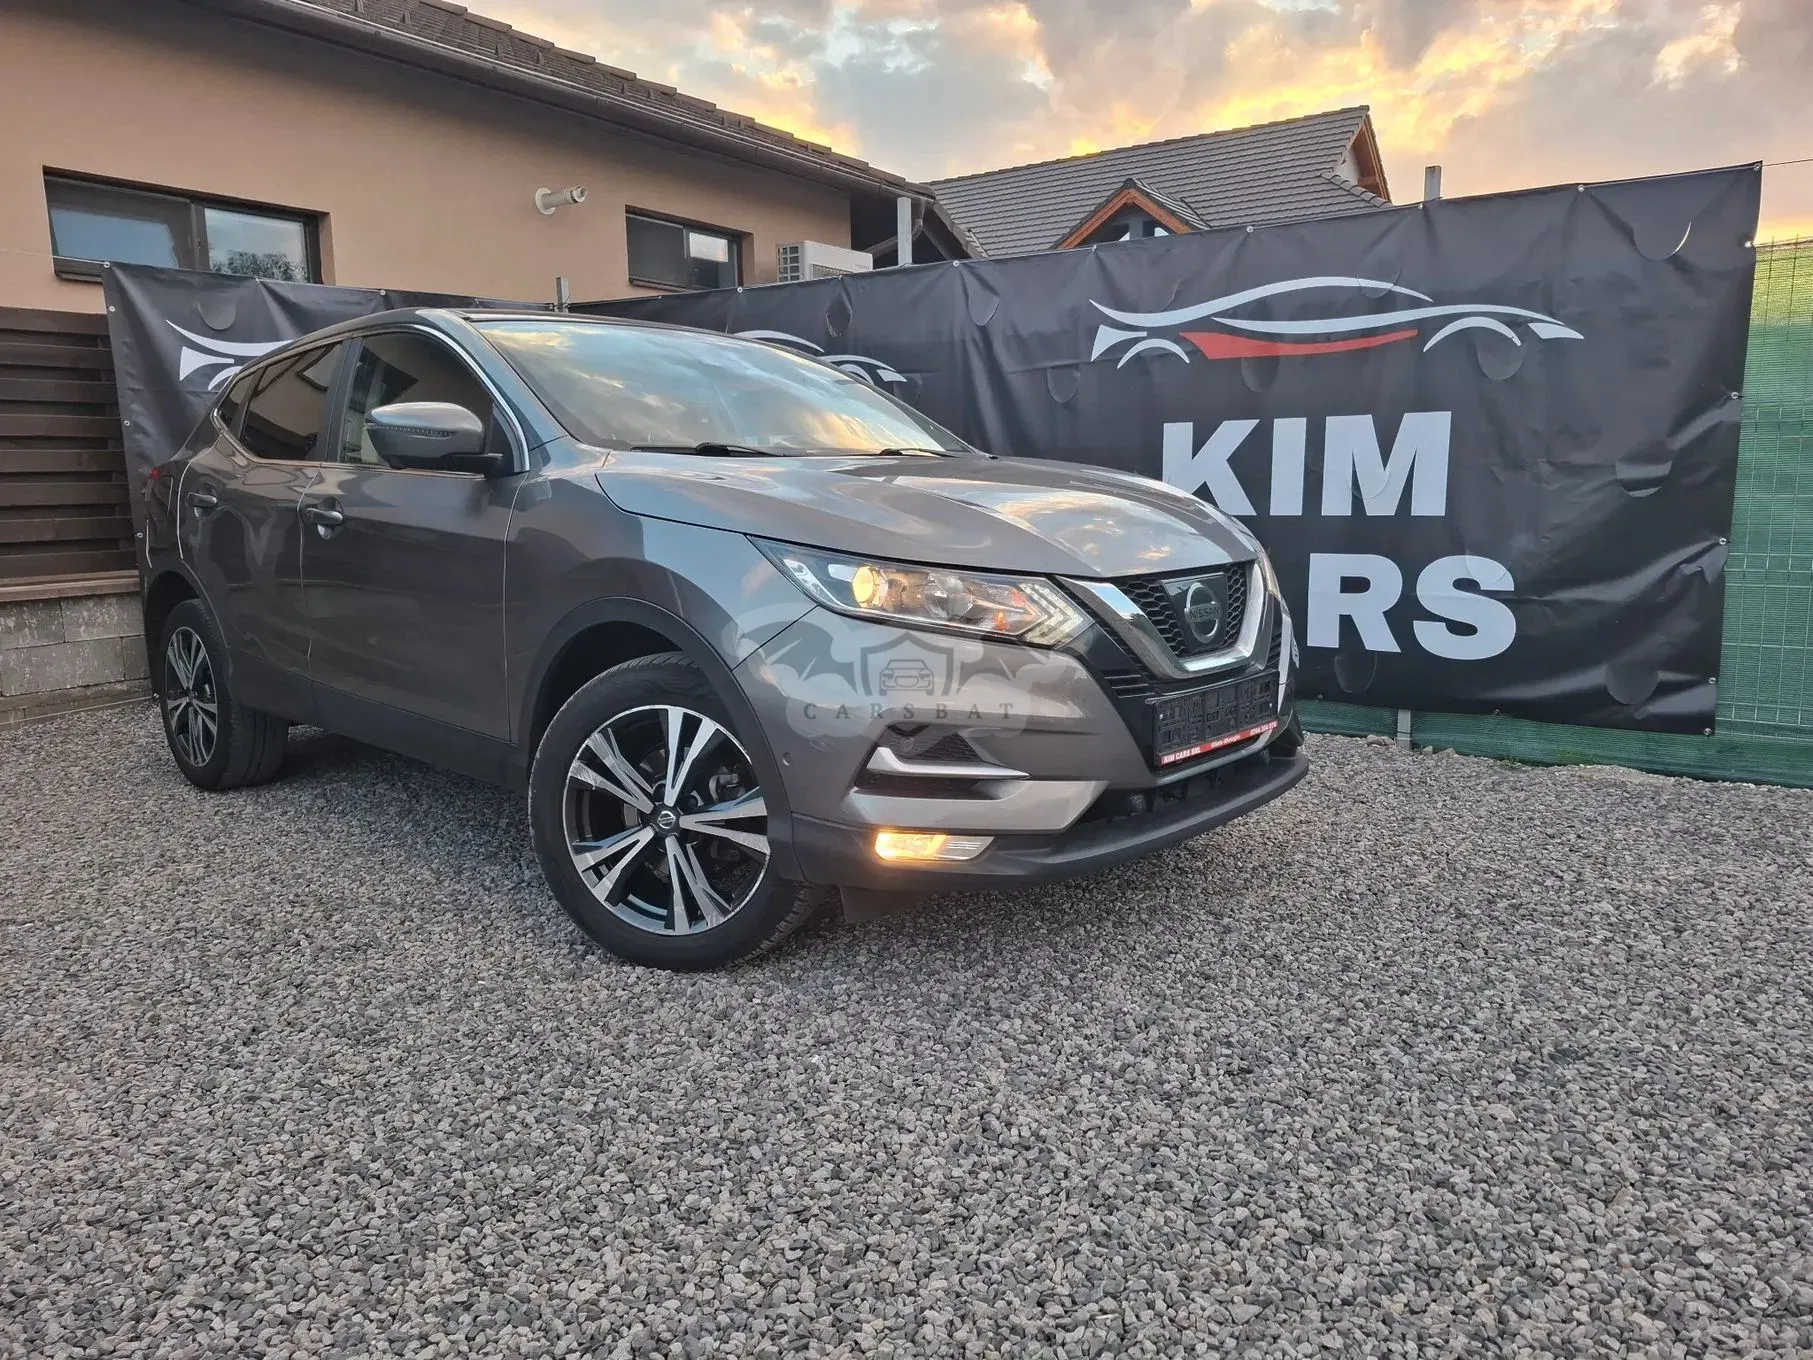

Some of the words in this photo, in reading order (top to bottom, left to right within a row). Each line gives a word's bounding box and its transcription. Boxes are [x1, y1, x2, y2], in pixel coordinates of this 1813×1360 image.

[1162, 411, 1452, 516] KIM
[1188, 606, 1220, 619] NISSAN
[1307, 553, 1517, 660] RS
